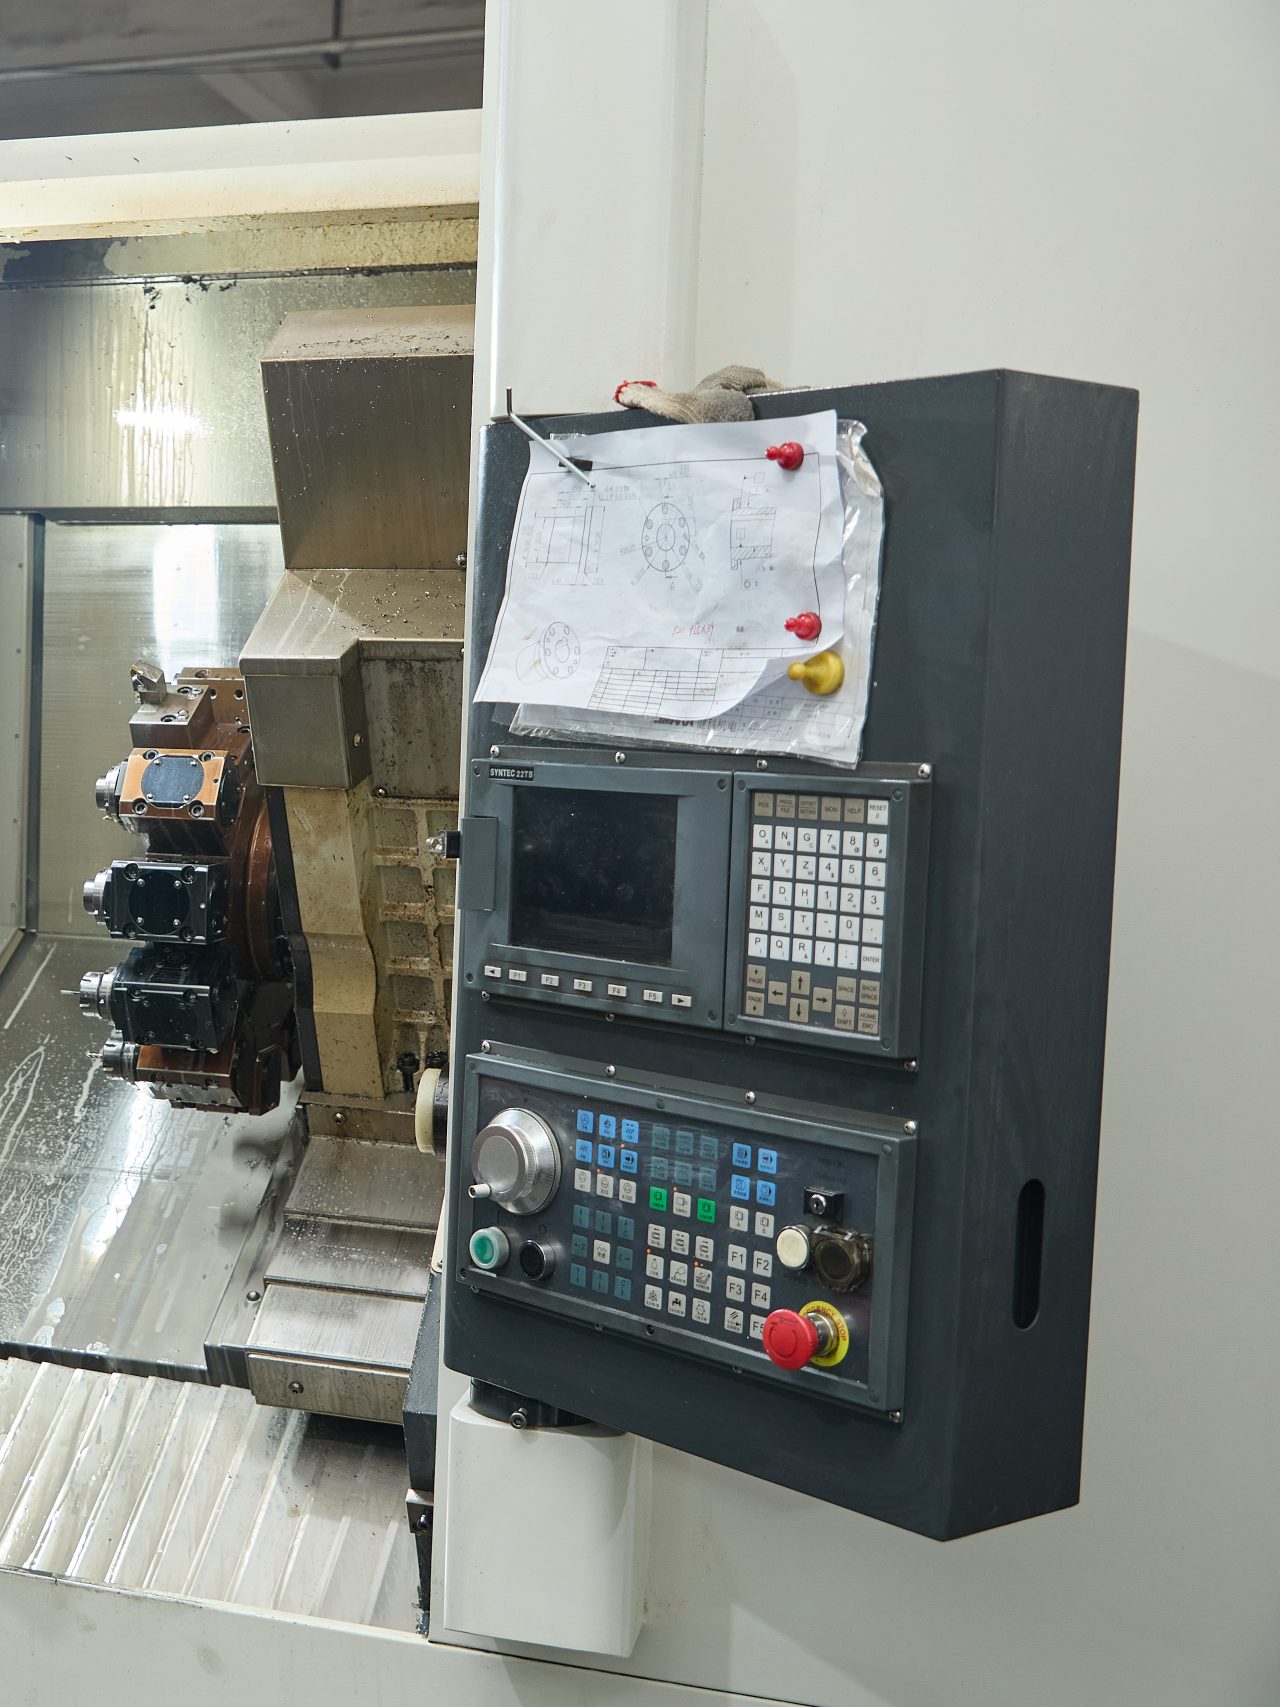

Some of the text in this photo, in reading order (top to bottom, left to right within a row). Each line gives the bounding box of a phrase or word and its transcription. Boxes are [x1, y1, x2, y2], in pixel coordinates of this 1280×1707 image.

[490, 768, 533, 778] SYNTEC 22TB
[781, 832, 788, 840] N
[803, 833, 811, 841] G
[827, 834, 833, 843] 7
[850, 836, 856, 845] 8
[873, 838, 880, 847] 9
[758, 857, 764, 865] X
[780, 859, 787, 867] Y
[802, 861, 809, 870] Z
[825, 862, 831, 871] 4
[849, 865, 854, 873] 5
[872, 867, 878, 876] 6
[758, 884, 763, 893] F
[779, 887, 785, 895] D
[802, 889, 808, 897] H
[825, 891, 829, 899] 1
[848, 893, 854, 902] 2
[871, 895, 877, 904] 3
[755, 910, 763, 919] M
[778, 913, 784, 921] S
[801, 915, 806, 923] T
[846, 920, 852, 929] 0
[755, 937, 761, 945] P
[776, 940, 783, 949] Q
[799, 943, 805, 951] R
[731, 1251, 744, 1264] F1
[756, 1258, 769, 1271] F2
[729, 1282, 742, 1295] F3
[754, 1290, 768, 1302] F4
[837, 1318, 847, 1341] STOP
